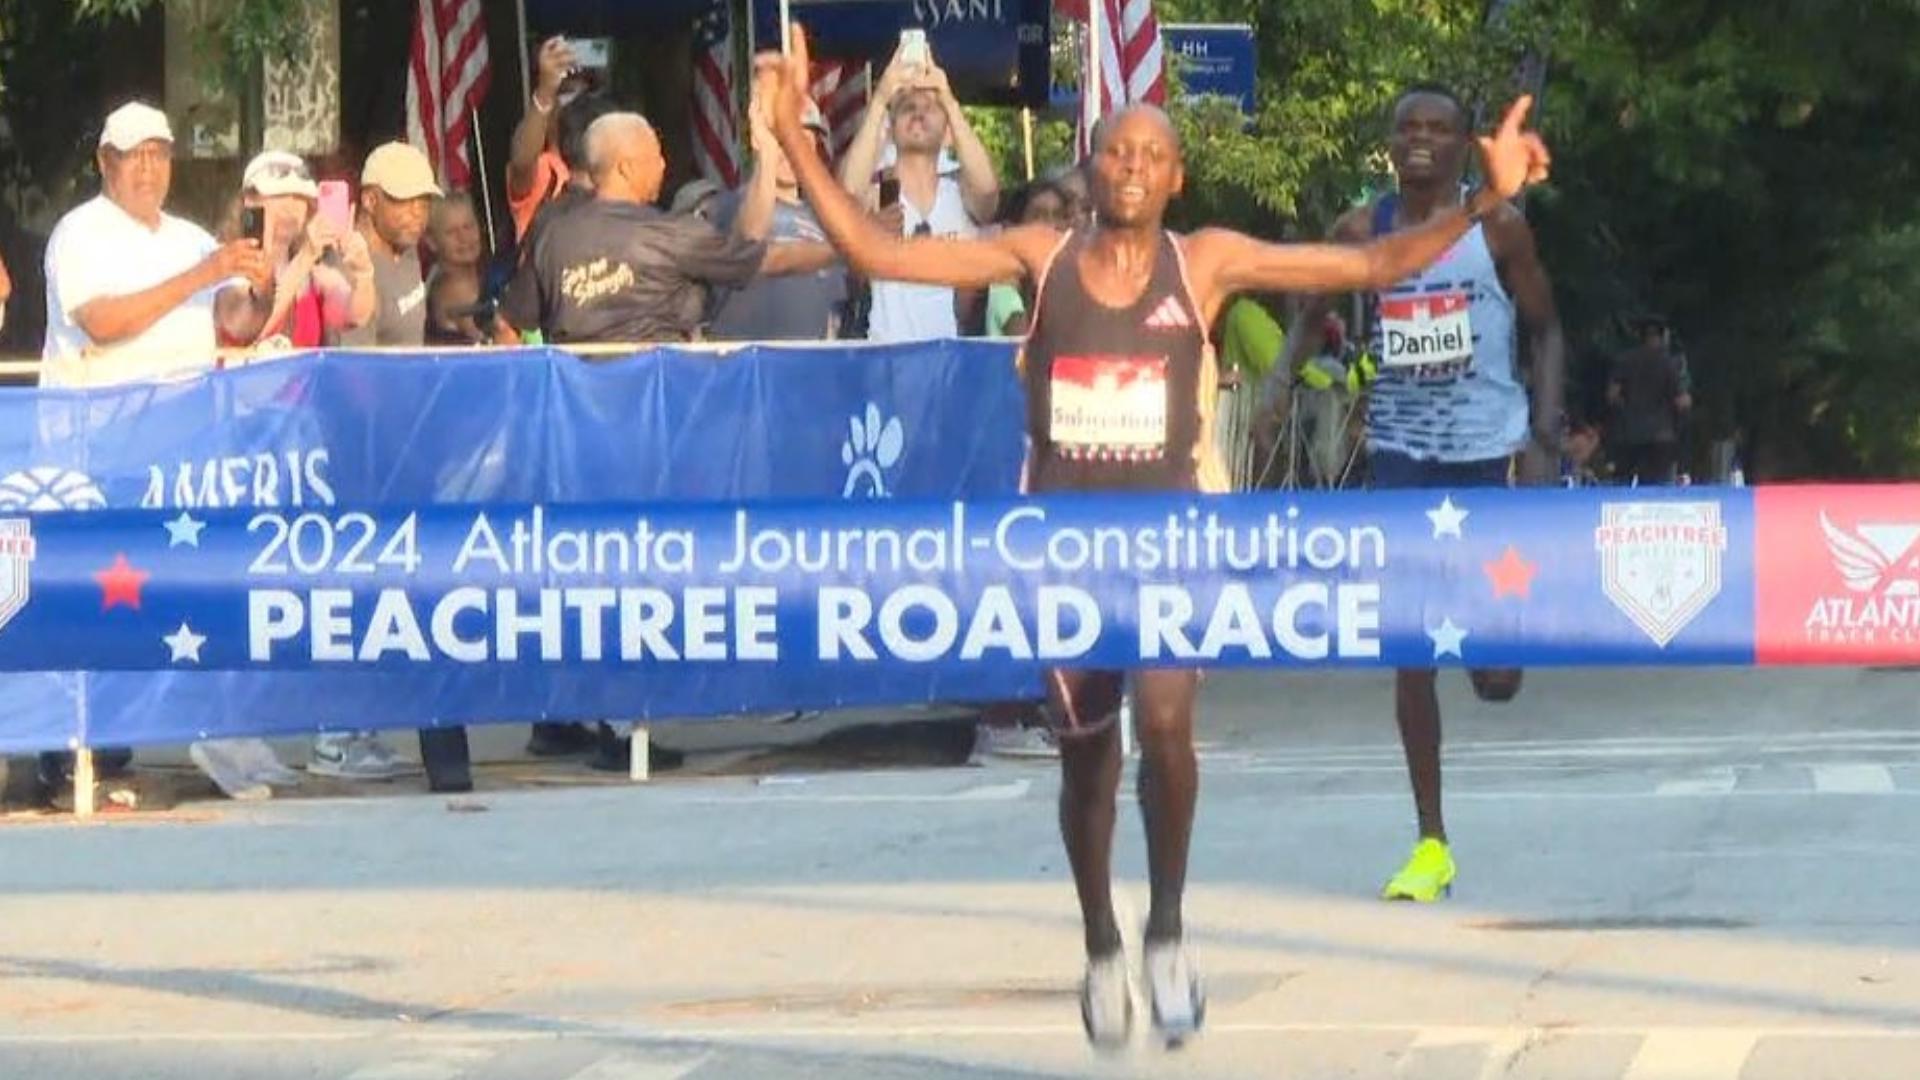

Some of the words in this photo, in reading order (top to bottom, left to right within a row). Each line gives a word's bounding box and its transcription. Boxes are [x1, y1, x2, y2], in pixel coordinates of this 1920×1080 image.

[1388, 323, 1464, 356] Daniel
[247, 510, 422, 574] 2024
[452, 504, 694, 574] Atlanta
[719, 501, 1386, 573] Journal-Constitution
[248, 586, 778, 662] PEACHTREE
[818, 585, 1102, 661] ROAD
[1138, 582, 1381, 661] RACE
